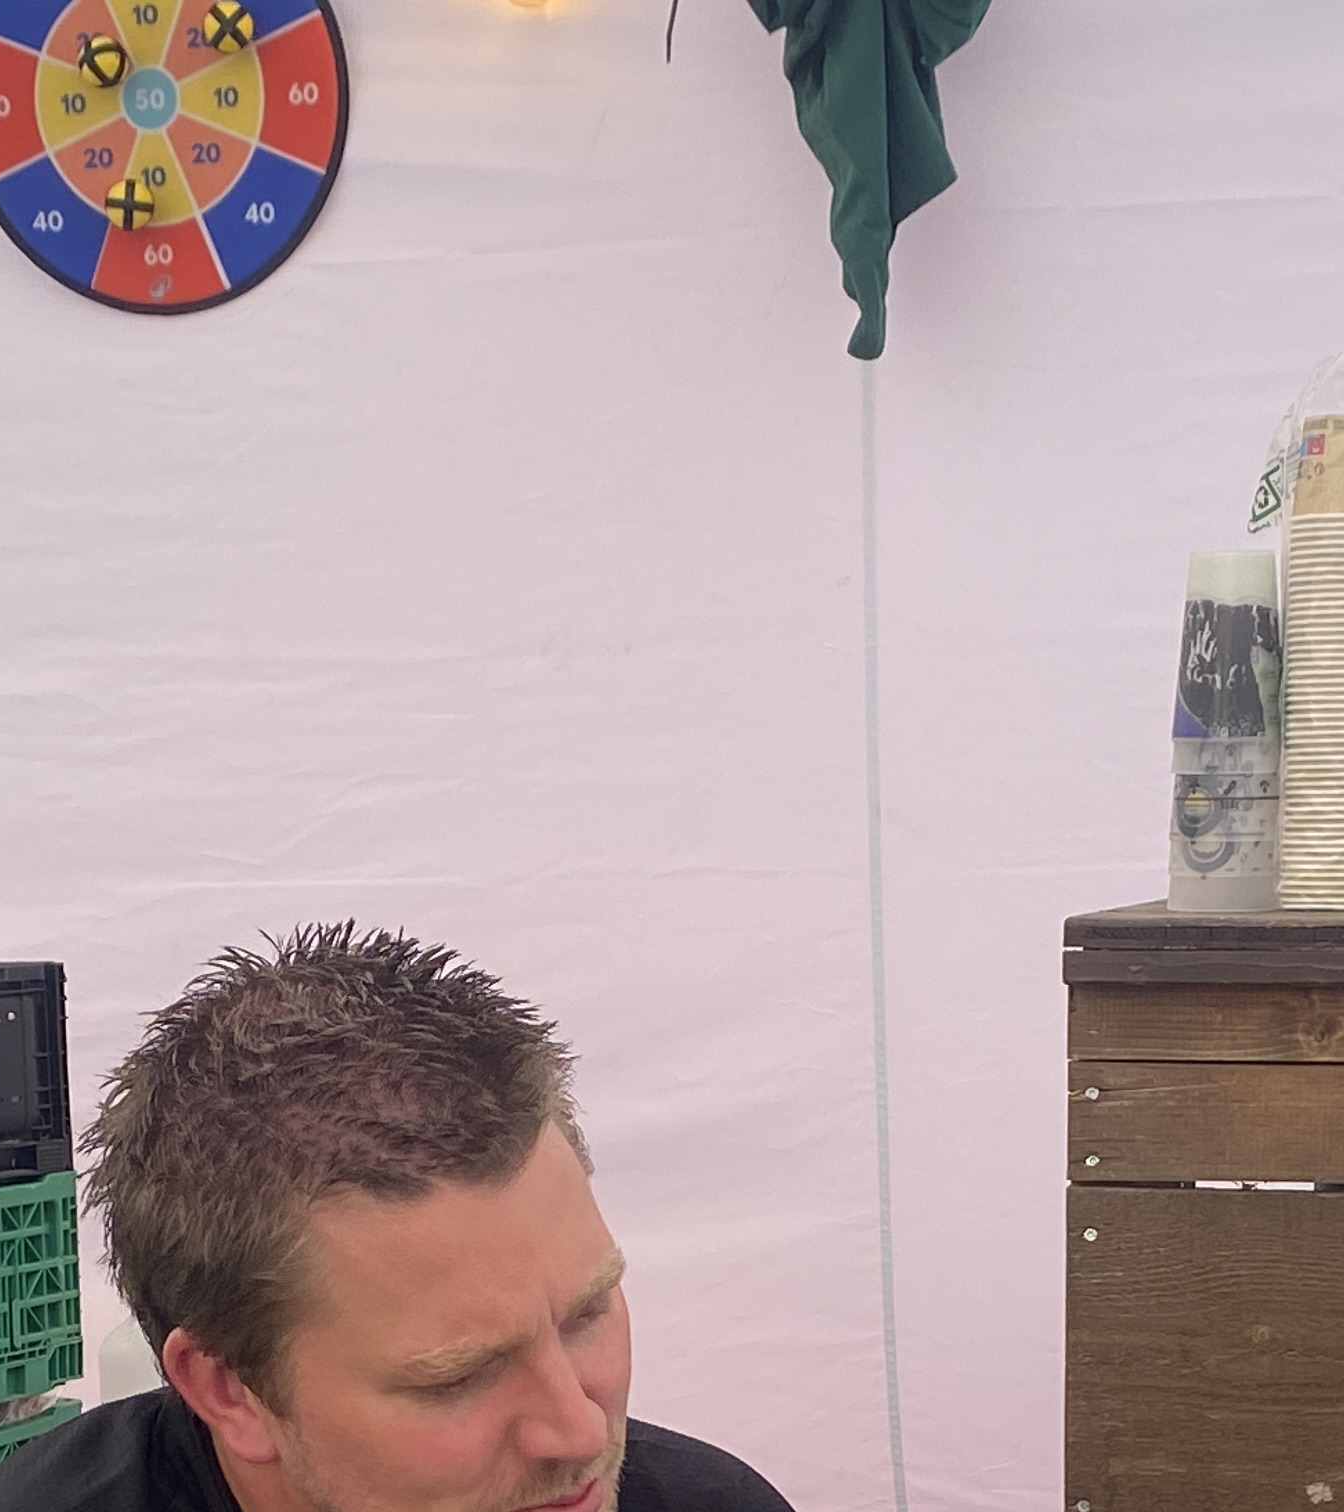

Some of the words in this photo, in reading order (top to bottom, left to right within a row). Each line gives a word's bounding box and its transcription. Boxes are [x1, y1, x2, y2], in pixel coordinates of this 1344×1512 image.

[133, 5, 158, 25] 10
[61, 93, 86, 114] 10
[135, 88, 165, 110] 50
[214, 86, 239, 108] 10
[288, 82, 319, 105] 60
[84, 148, 113, 168] 20
[192, 143, 220, 163] 20
[141, 165, 166, 187] 10
[32, 210, 64, 232] 40
[244, 201, 276, 224] 40
[143, 244, 174, 265] 60
